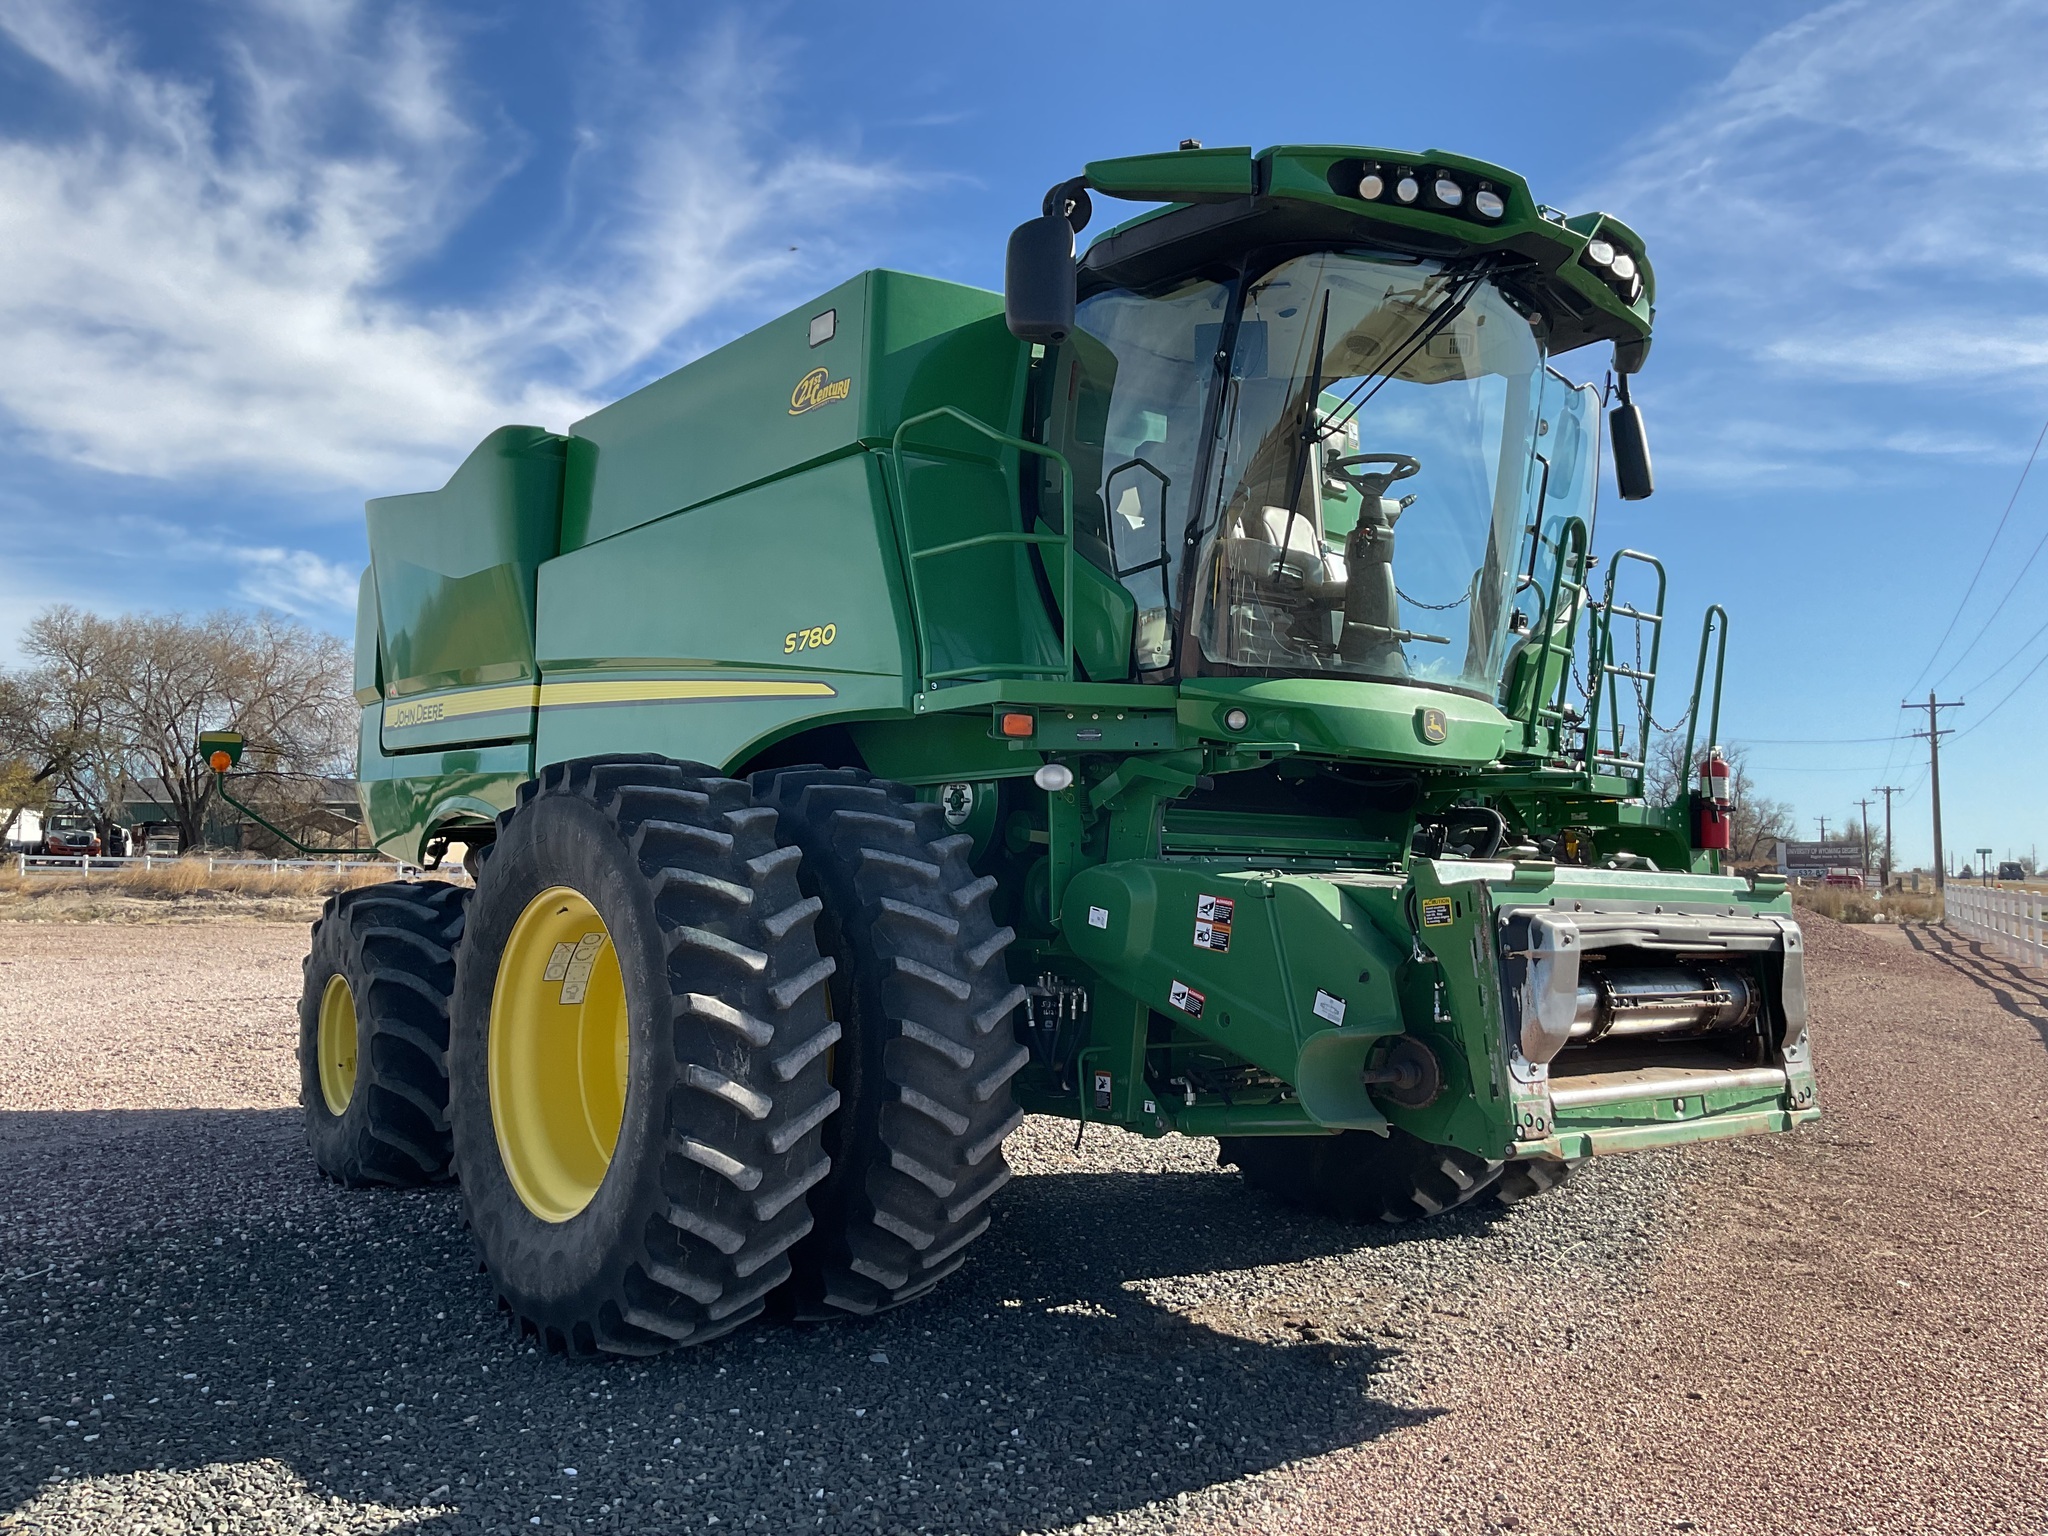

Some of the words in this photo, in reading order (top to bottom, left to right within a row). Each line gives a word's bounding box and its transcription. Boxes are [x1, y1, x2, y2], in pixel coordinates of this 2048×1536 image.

[810, 378, 851, 405] Century
[784, 622, 837, 655] S780
[394, 708, 415, 727] JOHN
[416, 703, 445, 724] DEERE
